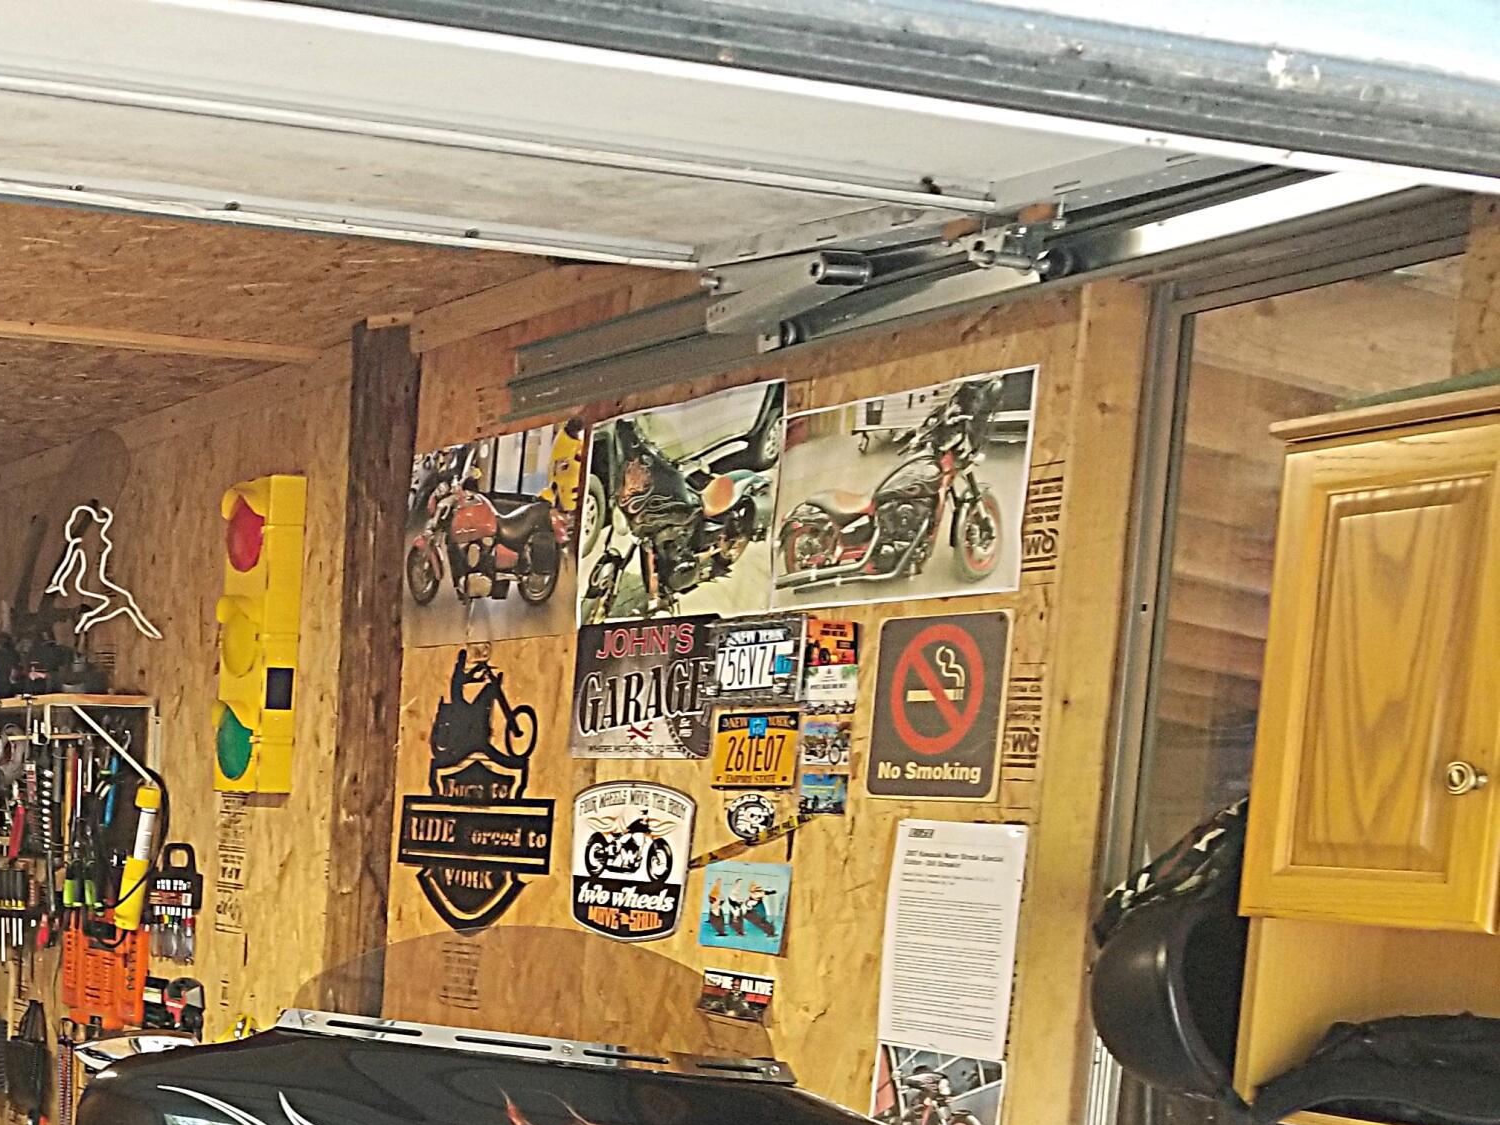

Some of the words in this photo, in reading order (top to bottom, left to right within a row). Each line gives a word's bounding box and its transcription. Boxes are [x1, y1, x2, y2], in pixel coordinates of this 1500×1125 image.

[596, 623, 695, 659] JOHN'S
[577, 657, 714, 737] GARAGE
[724, 735, 786, 772] 26TE07
[877, 762, 901, 779] No
[904, 762, 982, 784] Smoking
[492, 783, 509, 799] to
[466, 827, 522, 847] orced
[528, 831, 547, 849] to
[578, 881, 611, 905] two
[612, 885, 675, 912] wheels
